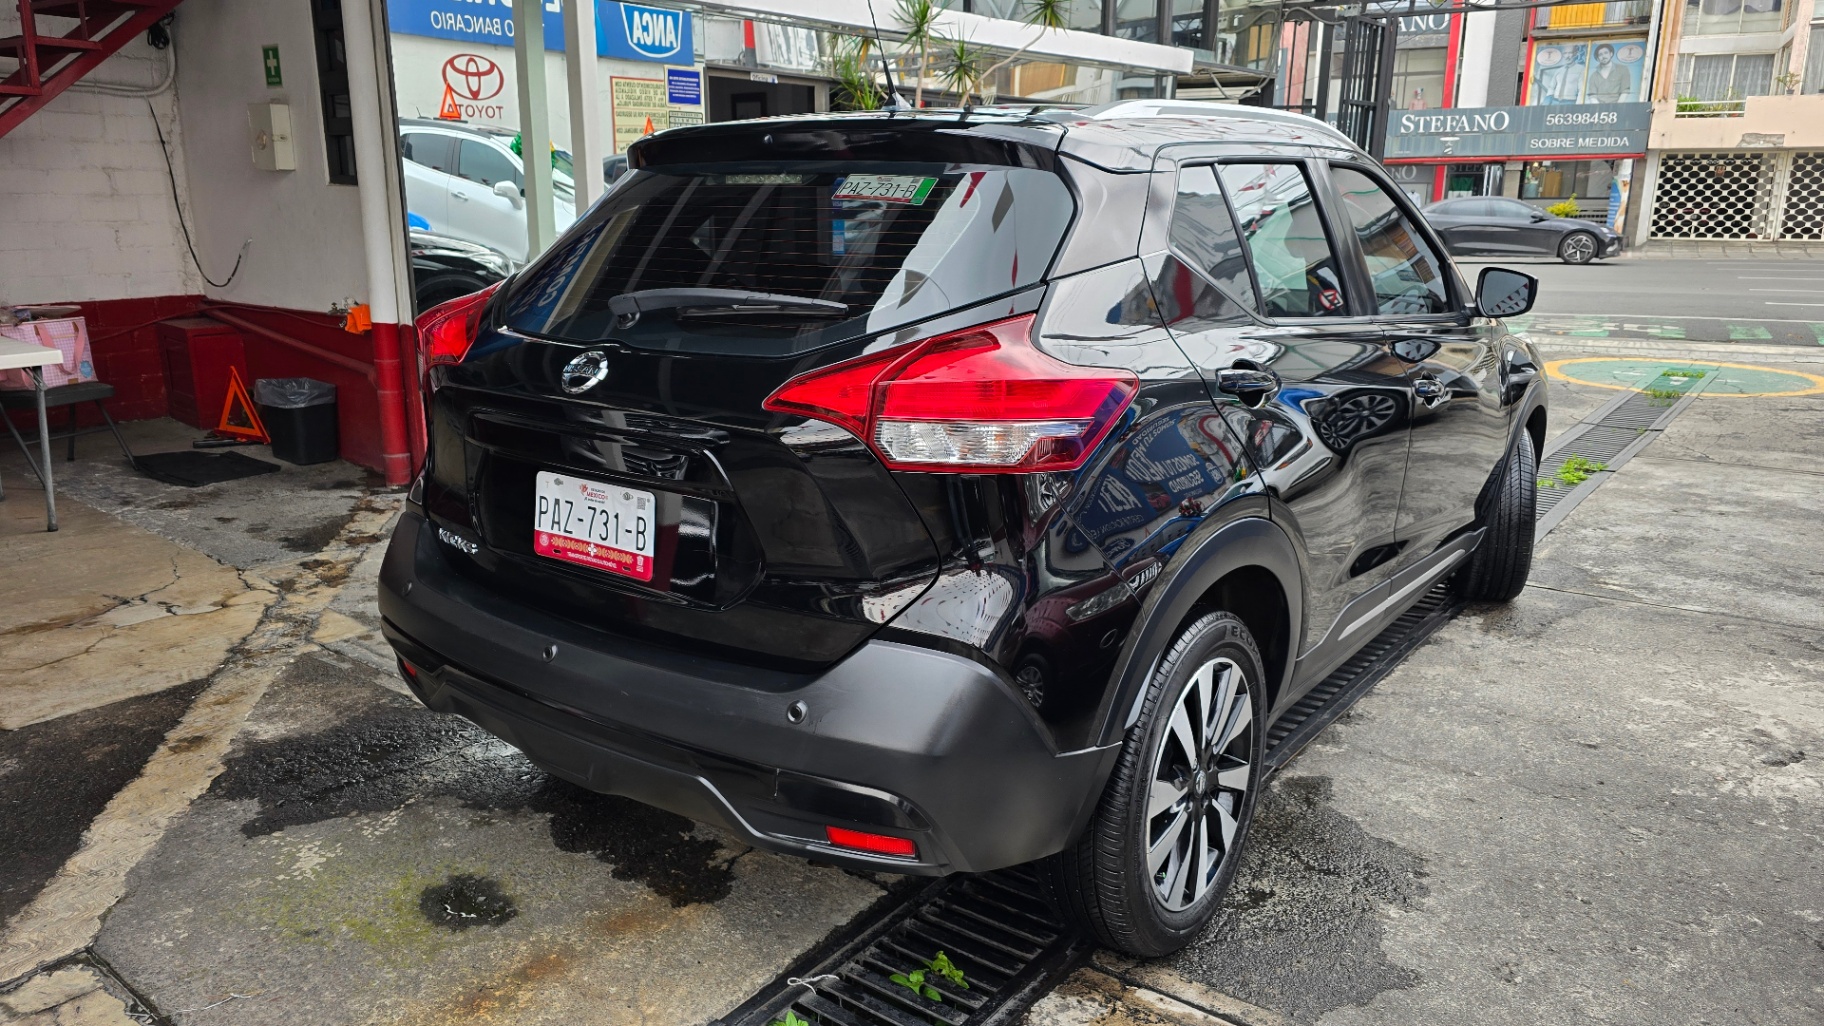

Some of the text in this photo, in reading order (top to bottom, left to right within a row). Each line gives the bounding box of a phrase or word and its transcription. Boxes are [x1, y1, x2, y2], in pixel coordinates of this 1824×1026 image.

[1400, 110, 1618, 134] STEFANO 56398458
[1530, 136, 1630, 149] SOBRE MEDIDA
[840, 181, 918, 198] PAZ-731-B
[538, 495, 647, 552] PAZ-731-B
